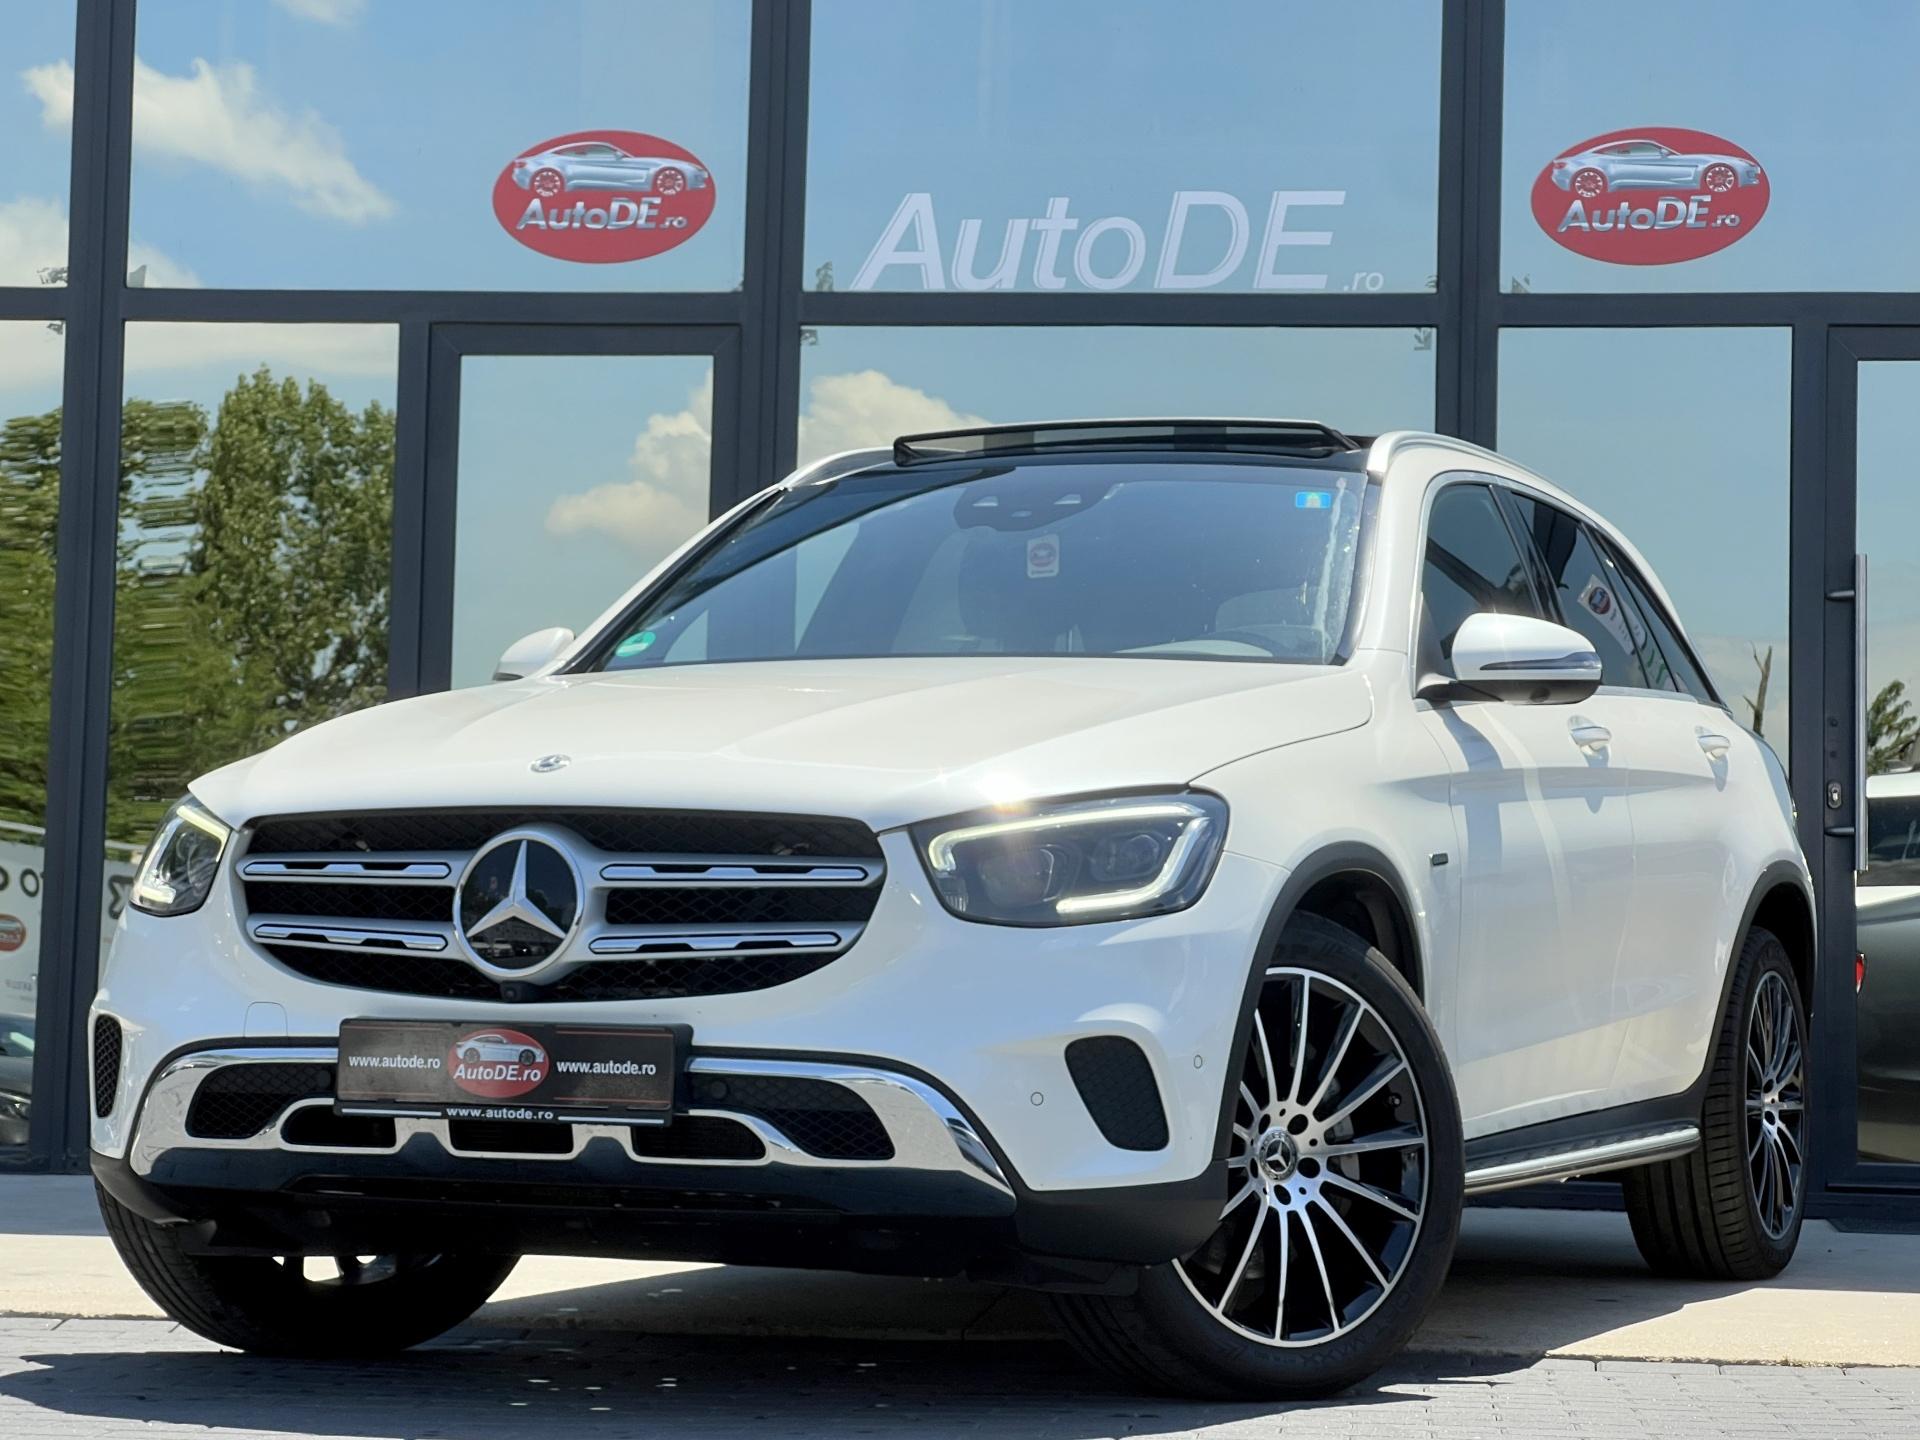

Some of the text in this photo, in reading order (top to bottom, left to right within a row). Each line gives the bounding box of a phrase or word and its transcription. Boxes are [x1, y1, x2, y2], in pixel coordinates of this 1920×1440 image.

[516, 197, 688, 230] AutoDE.ro
[1557, 195, 1741, 233] AutoDE.ro
[348, 1054, 441, 1069] www.autode.ro
[556, 1060, 657, 1076] www.autode.ro
[453, 1064, 542, 1082] AutoDE.ro
[446, 1107, 554, 1120] www.autode.ro
